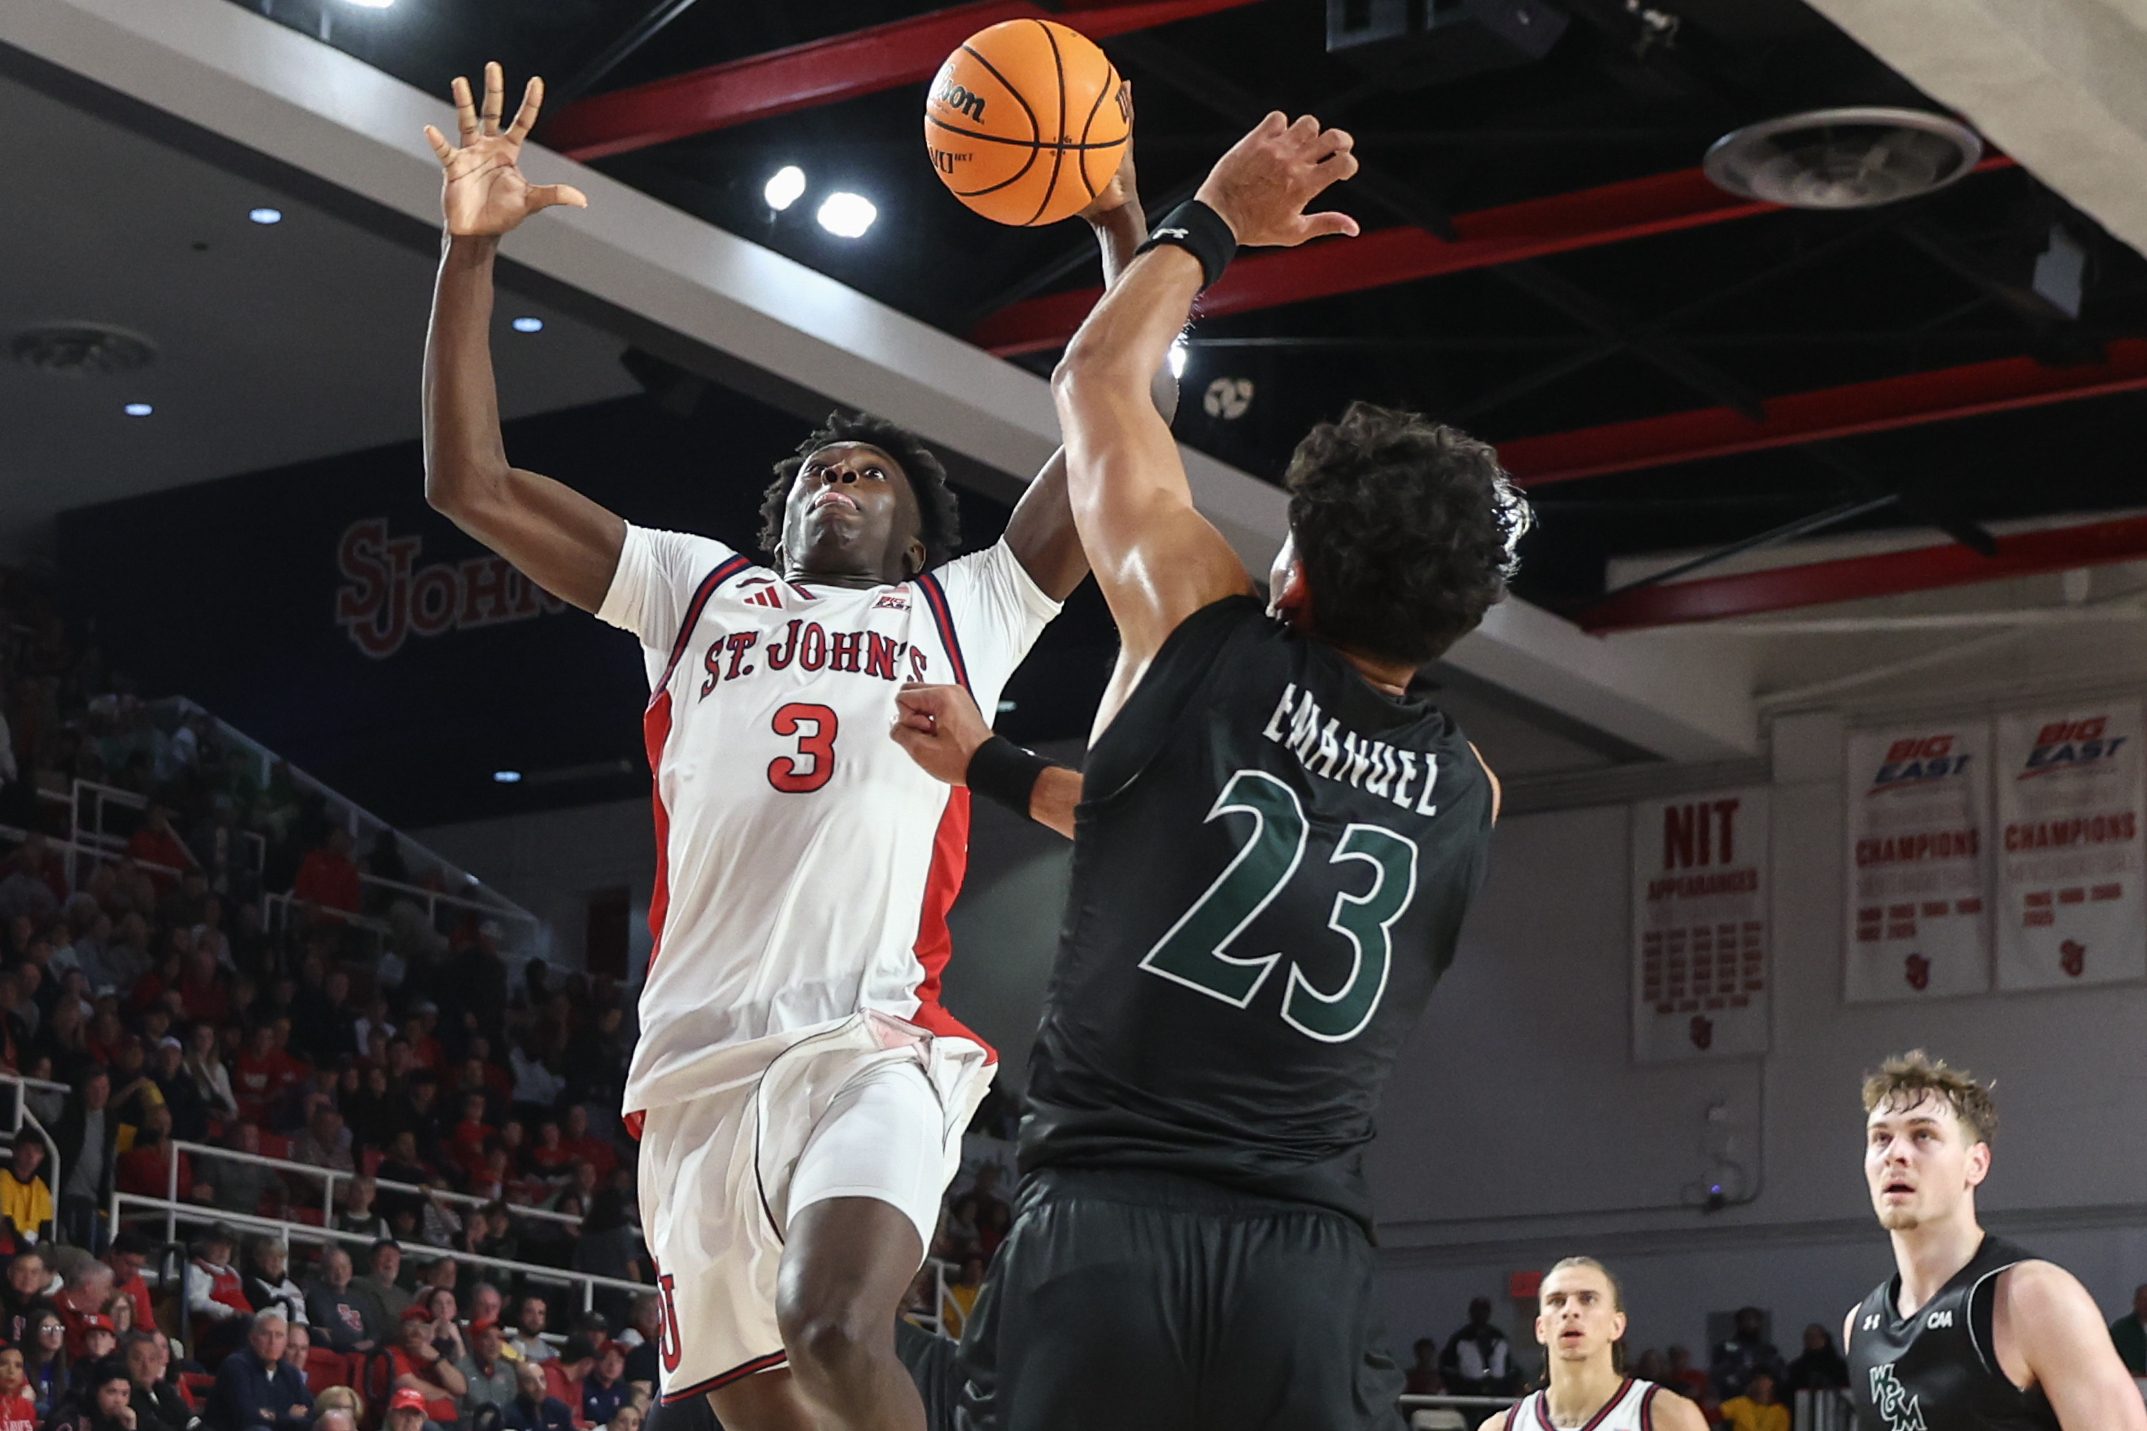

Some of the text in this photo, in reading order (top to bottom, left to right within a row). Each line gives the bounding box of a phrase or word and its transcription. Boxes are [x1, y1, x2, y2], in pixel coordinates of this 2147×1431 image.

[697, 630, 759, 704] ST.
[767, 701, 839, 794] 3
[1262, 682, 1438, 817] EMANUEL
[1886, 734, 1955, 764] BIG
[2036, 715, 2111, 747] BIG
[1874, 753, 1972, 784] EAST
[2025, 736, 2128, 769] EAST
[1664, 798, 1740, 869] NIT
[1856, 828, 1980, 867] CHAMPIONS
[2005, 811, 2137, 852] CHAMPIONS
[1137, 769, 1419, 1043] 23
[1926, 1310, 1953, 1330] CAA
